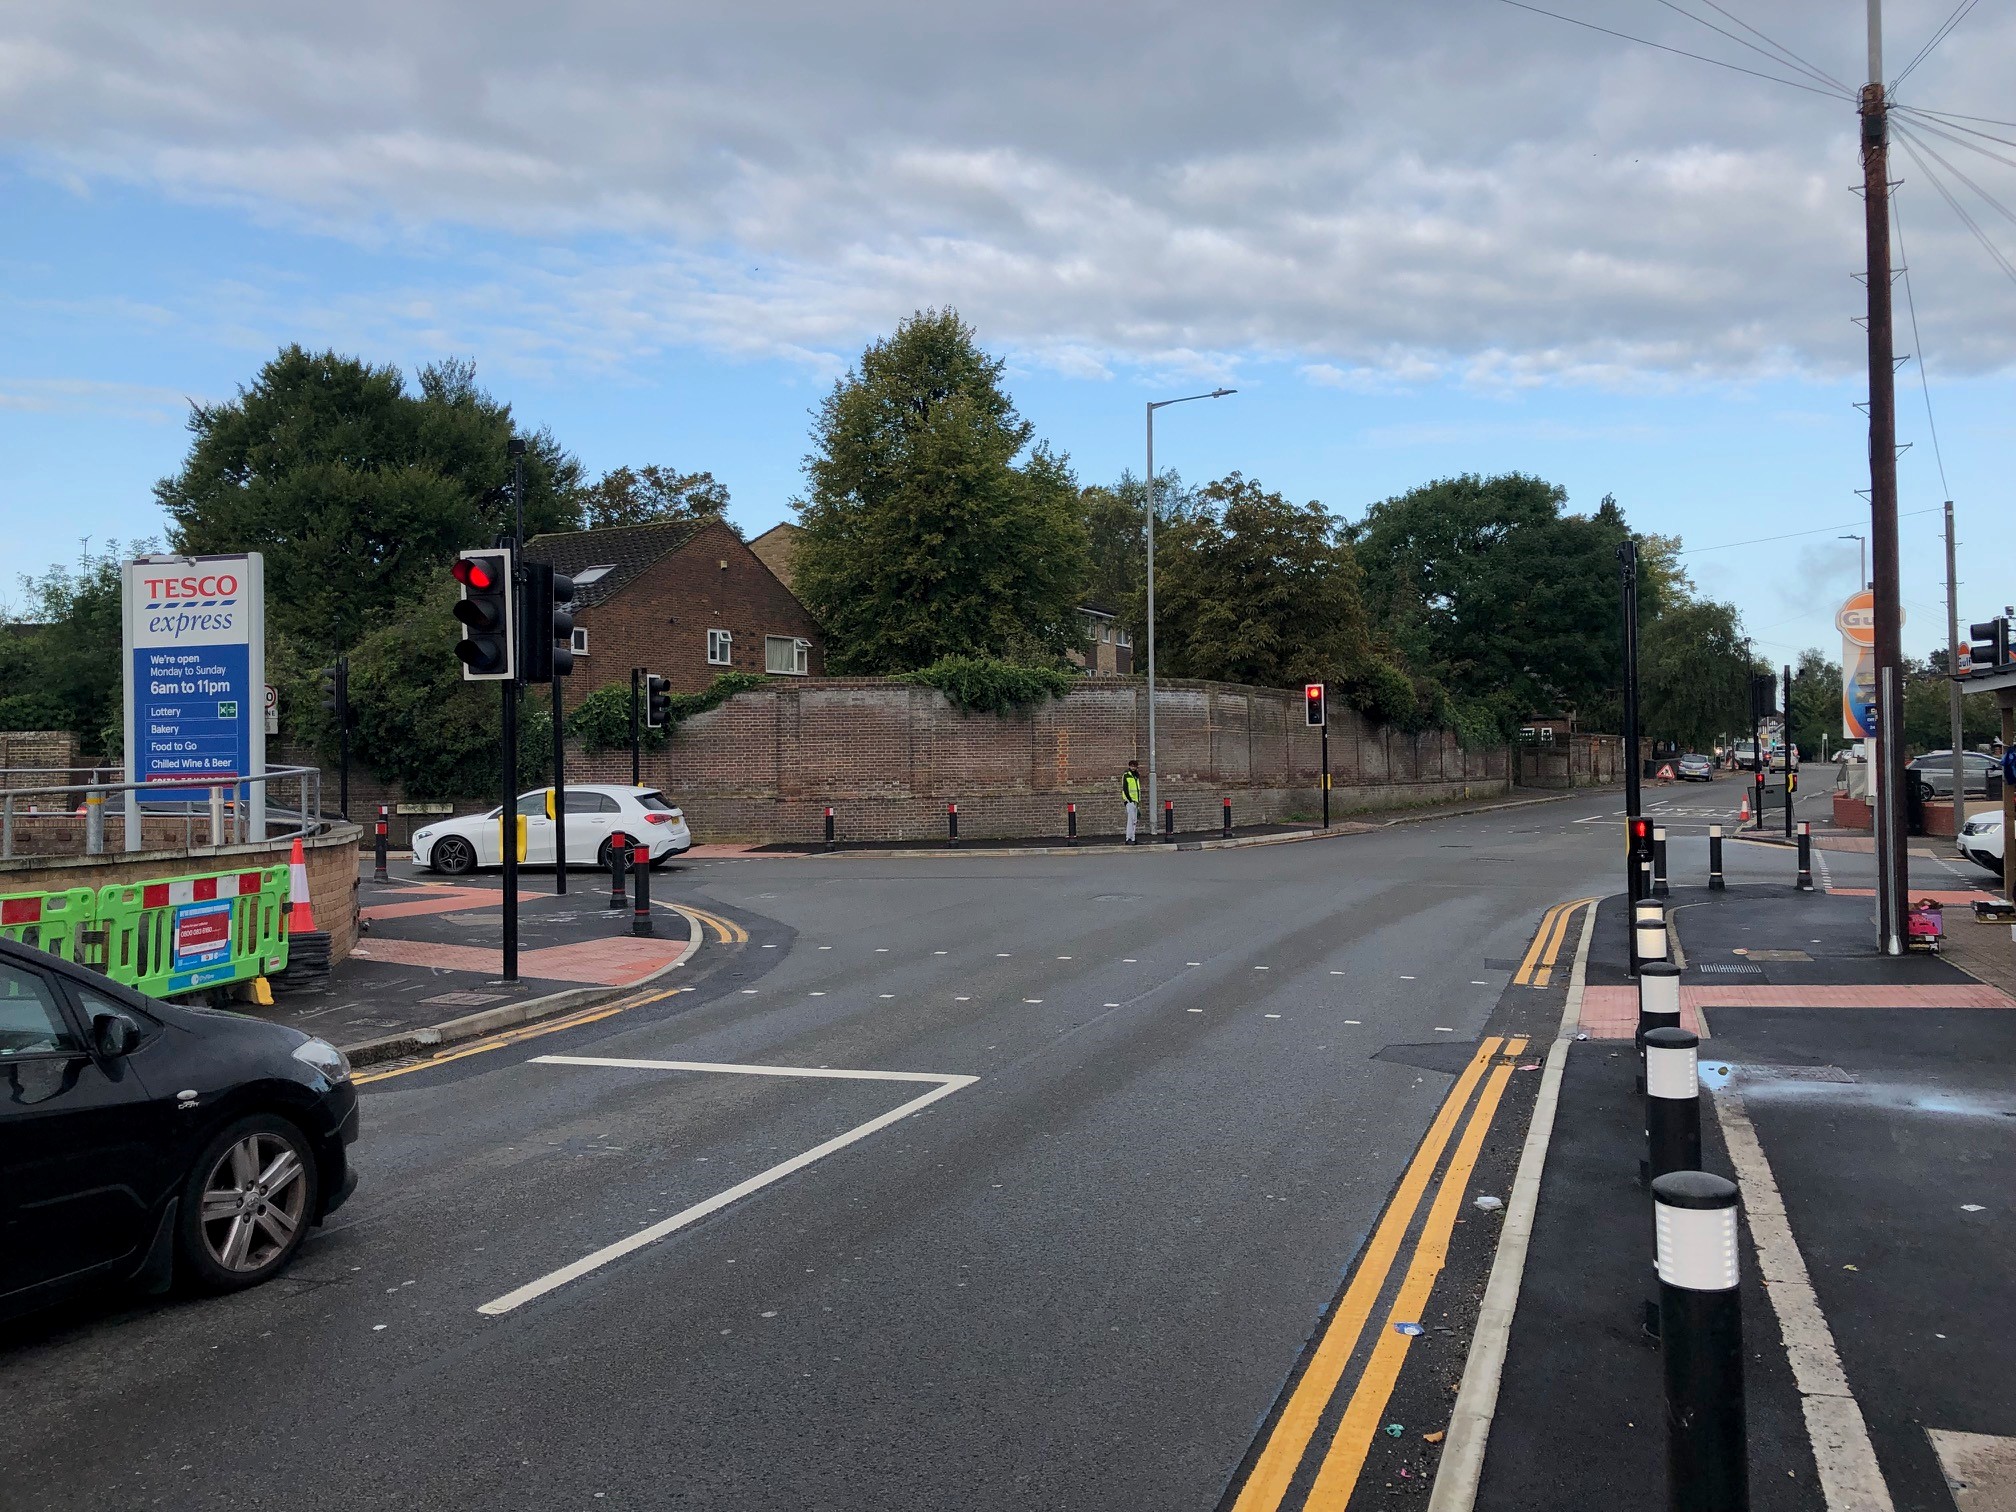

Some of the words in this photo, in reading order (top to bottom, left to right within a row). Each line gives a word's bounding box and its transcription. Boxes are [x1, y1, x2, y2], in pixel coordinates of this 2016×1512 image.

[144, 575, 238, 599] TESCO
[1843, 611, 1874, 626] Gu
[149, 613, 233, 639] express
[150, 655, 175, 664] We're
[177, 655, 200, 665] open
[150, 667, 183, 677] Monday
[184, 667, 194, 675] to
[196, 665, 226, 676] Sunday
[150, 681, 179, 694] 6am
[181, 681, 195, 693] to
[197, 679, 230, 696] 11pm
[151, 708, 181, 717] Lottery
[151, 725, 179, 735] Bakery
[151, 742, 172, 751] Food
[174, 742, 183, 750] to
[184, 741, 197, 750] Go
[151, 759, 180, 768] Chilled
[181, 759, 202, 768] Wine
[204, 758, 210, 767] &
[212, 758, 232, 767] Beer
